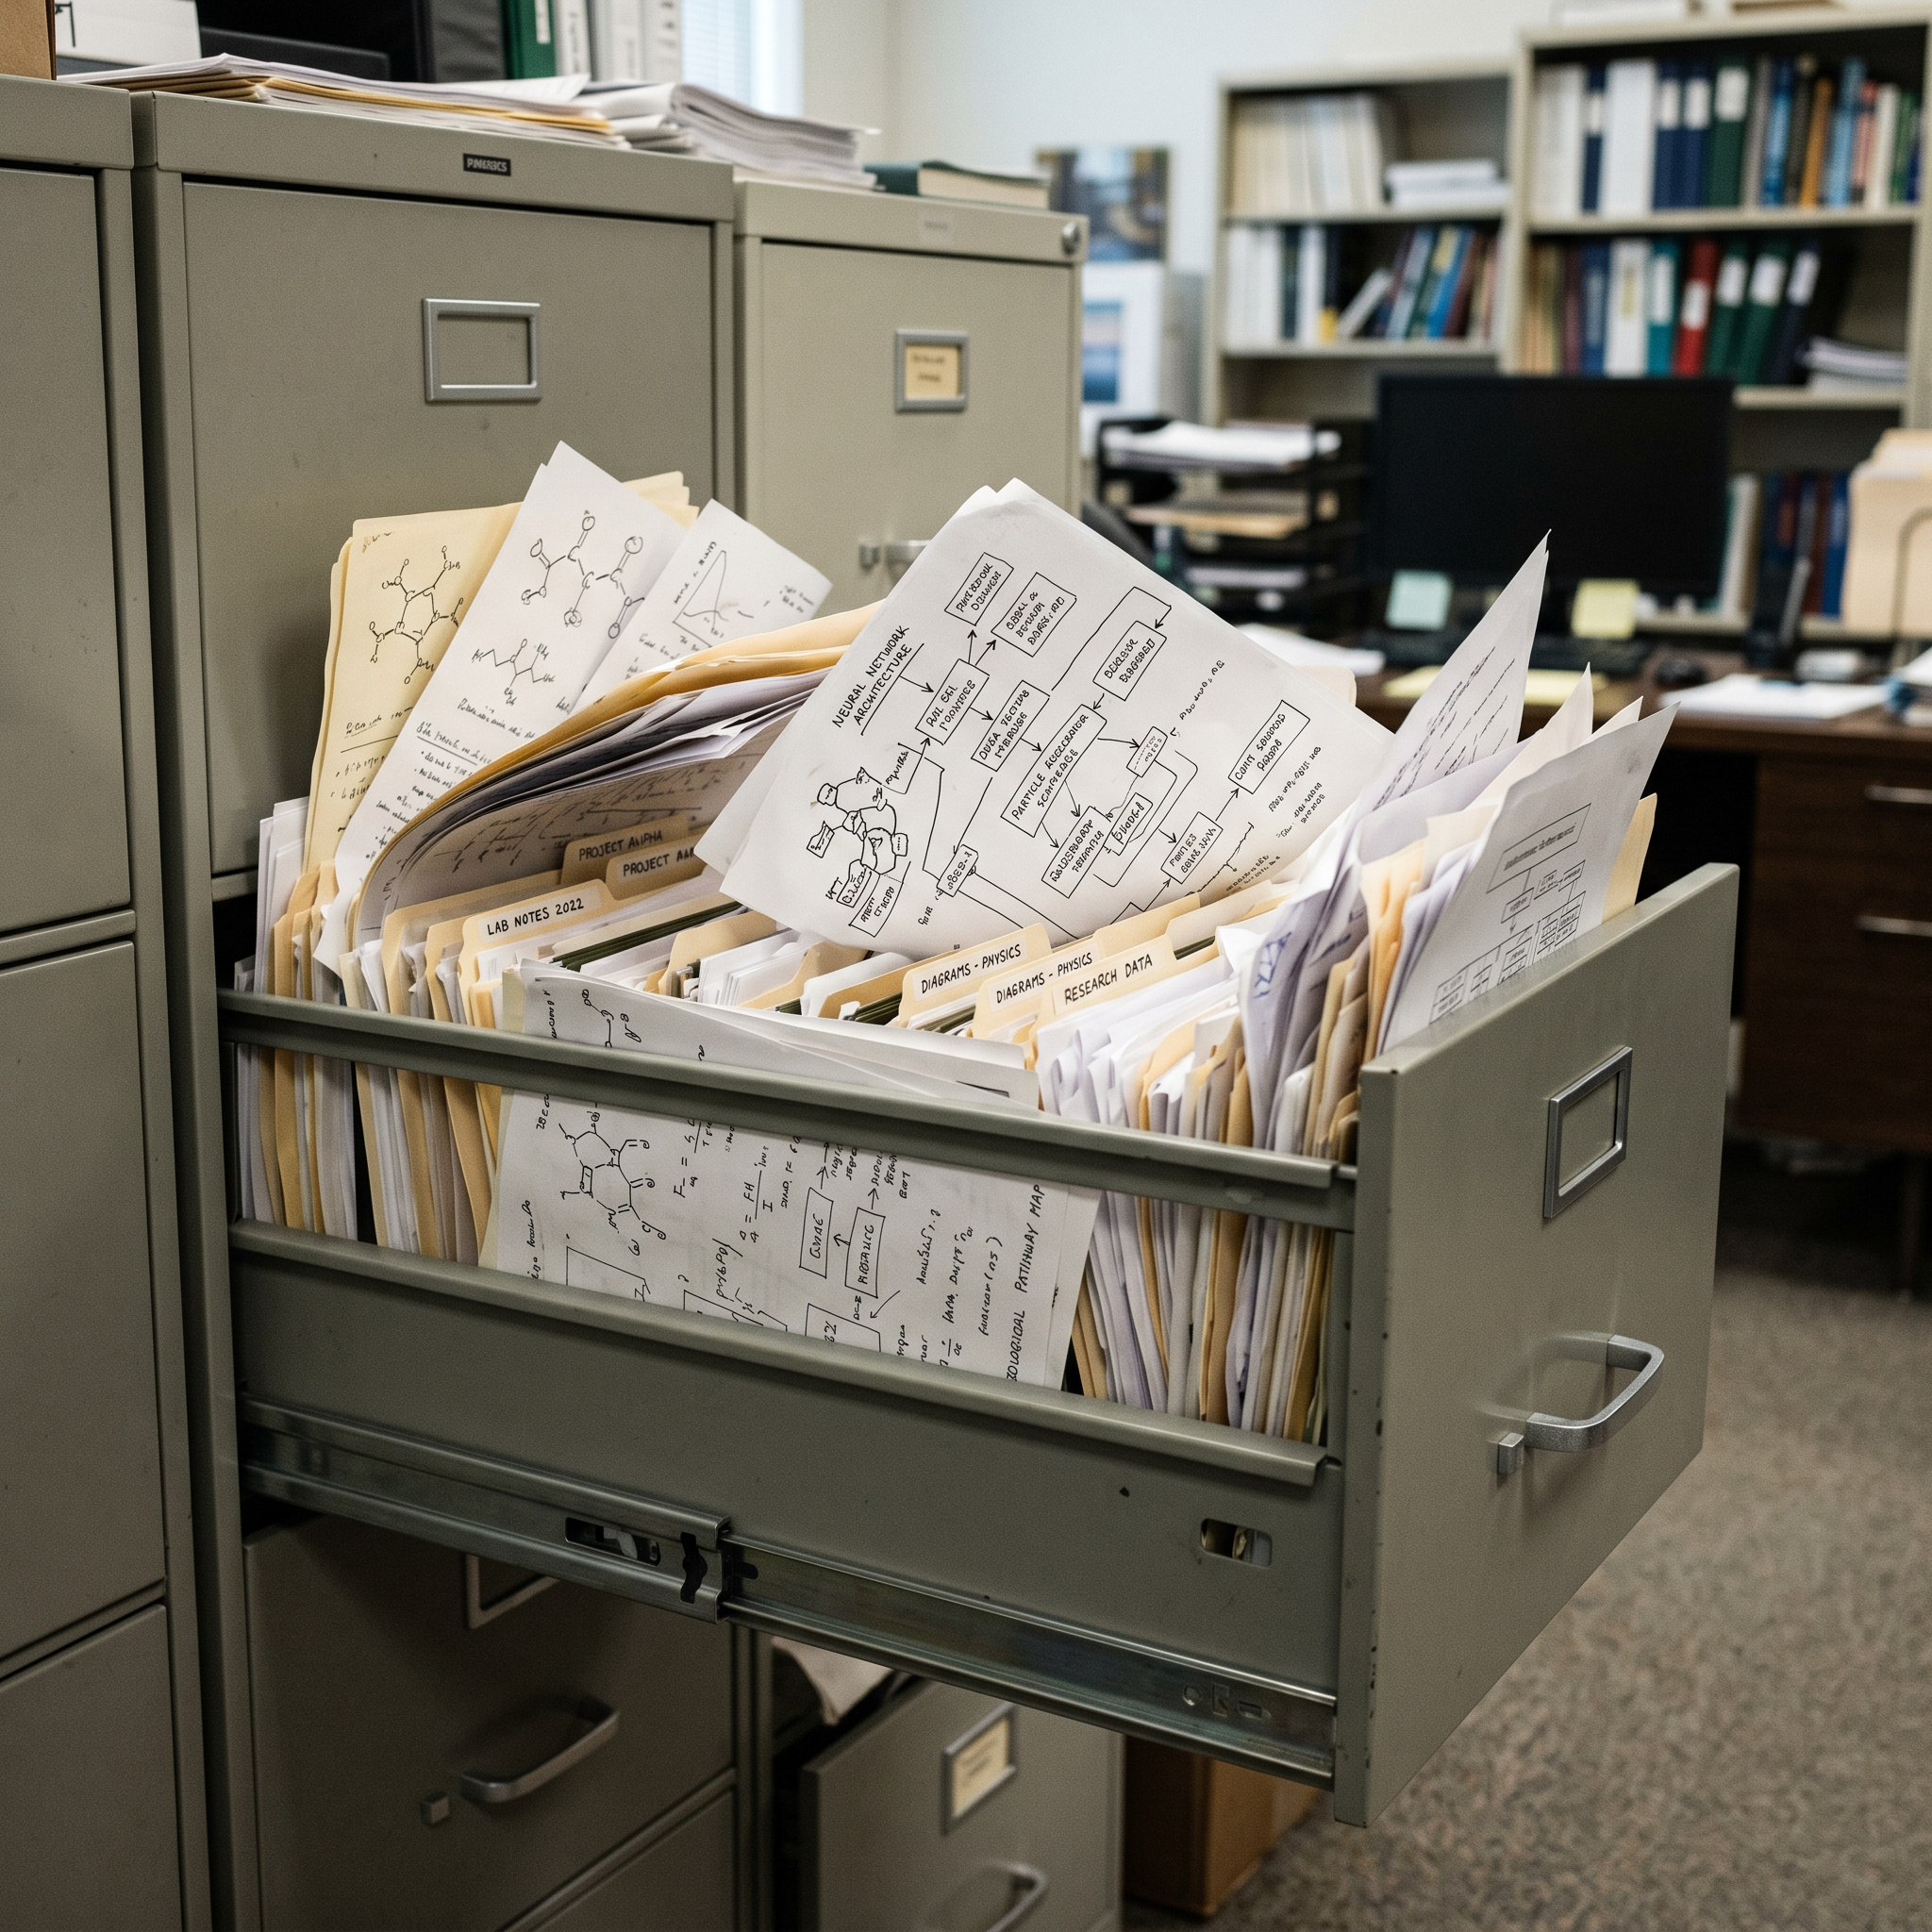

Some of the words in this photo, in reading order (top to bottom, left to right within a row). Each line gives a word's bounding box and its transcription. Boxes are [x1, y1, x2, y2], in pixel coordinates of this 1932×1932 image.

[832, 683, 866, 728] NEURAL
[865, 625, 910, 677] NETWORK
[853, 643, 912, 726] ARCHITECTURE
[1011, 773, 1046, 820] PARTICLE
[578, 839, 625, 861] PROJECT
[623, 853, 670, 876] PROJECT
[487, 919, 509, 936] LAB
[514, 907, 550, 928] NOTES
[555, 897, 585, 916] 2022
[921, 962, 971, 994] DIAGRAMS
[996, 972, 1045, 1004] DIAGRAMS
[1058, 952, 1093, 977] PHYSICS
[1064, 968, 1118, 1005] RESEARCH
[1124, 953, 1154, 978] DATA
[1029, 1184, 1045, 1218] MAP
